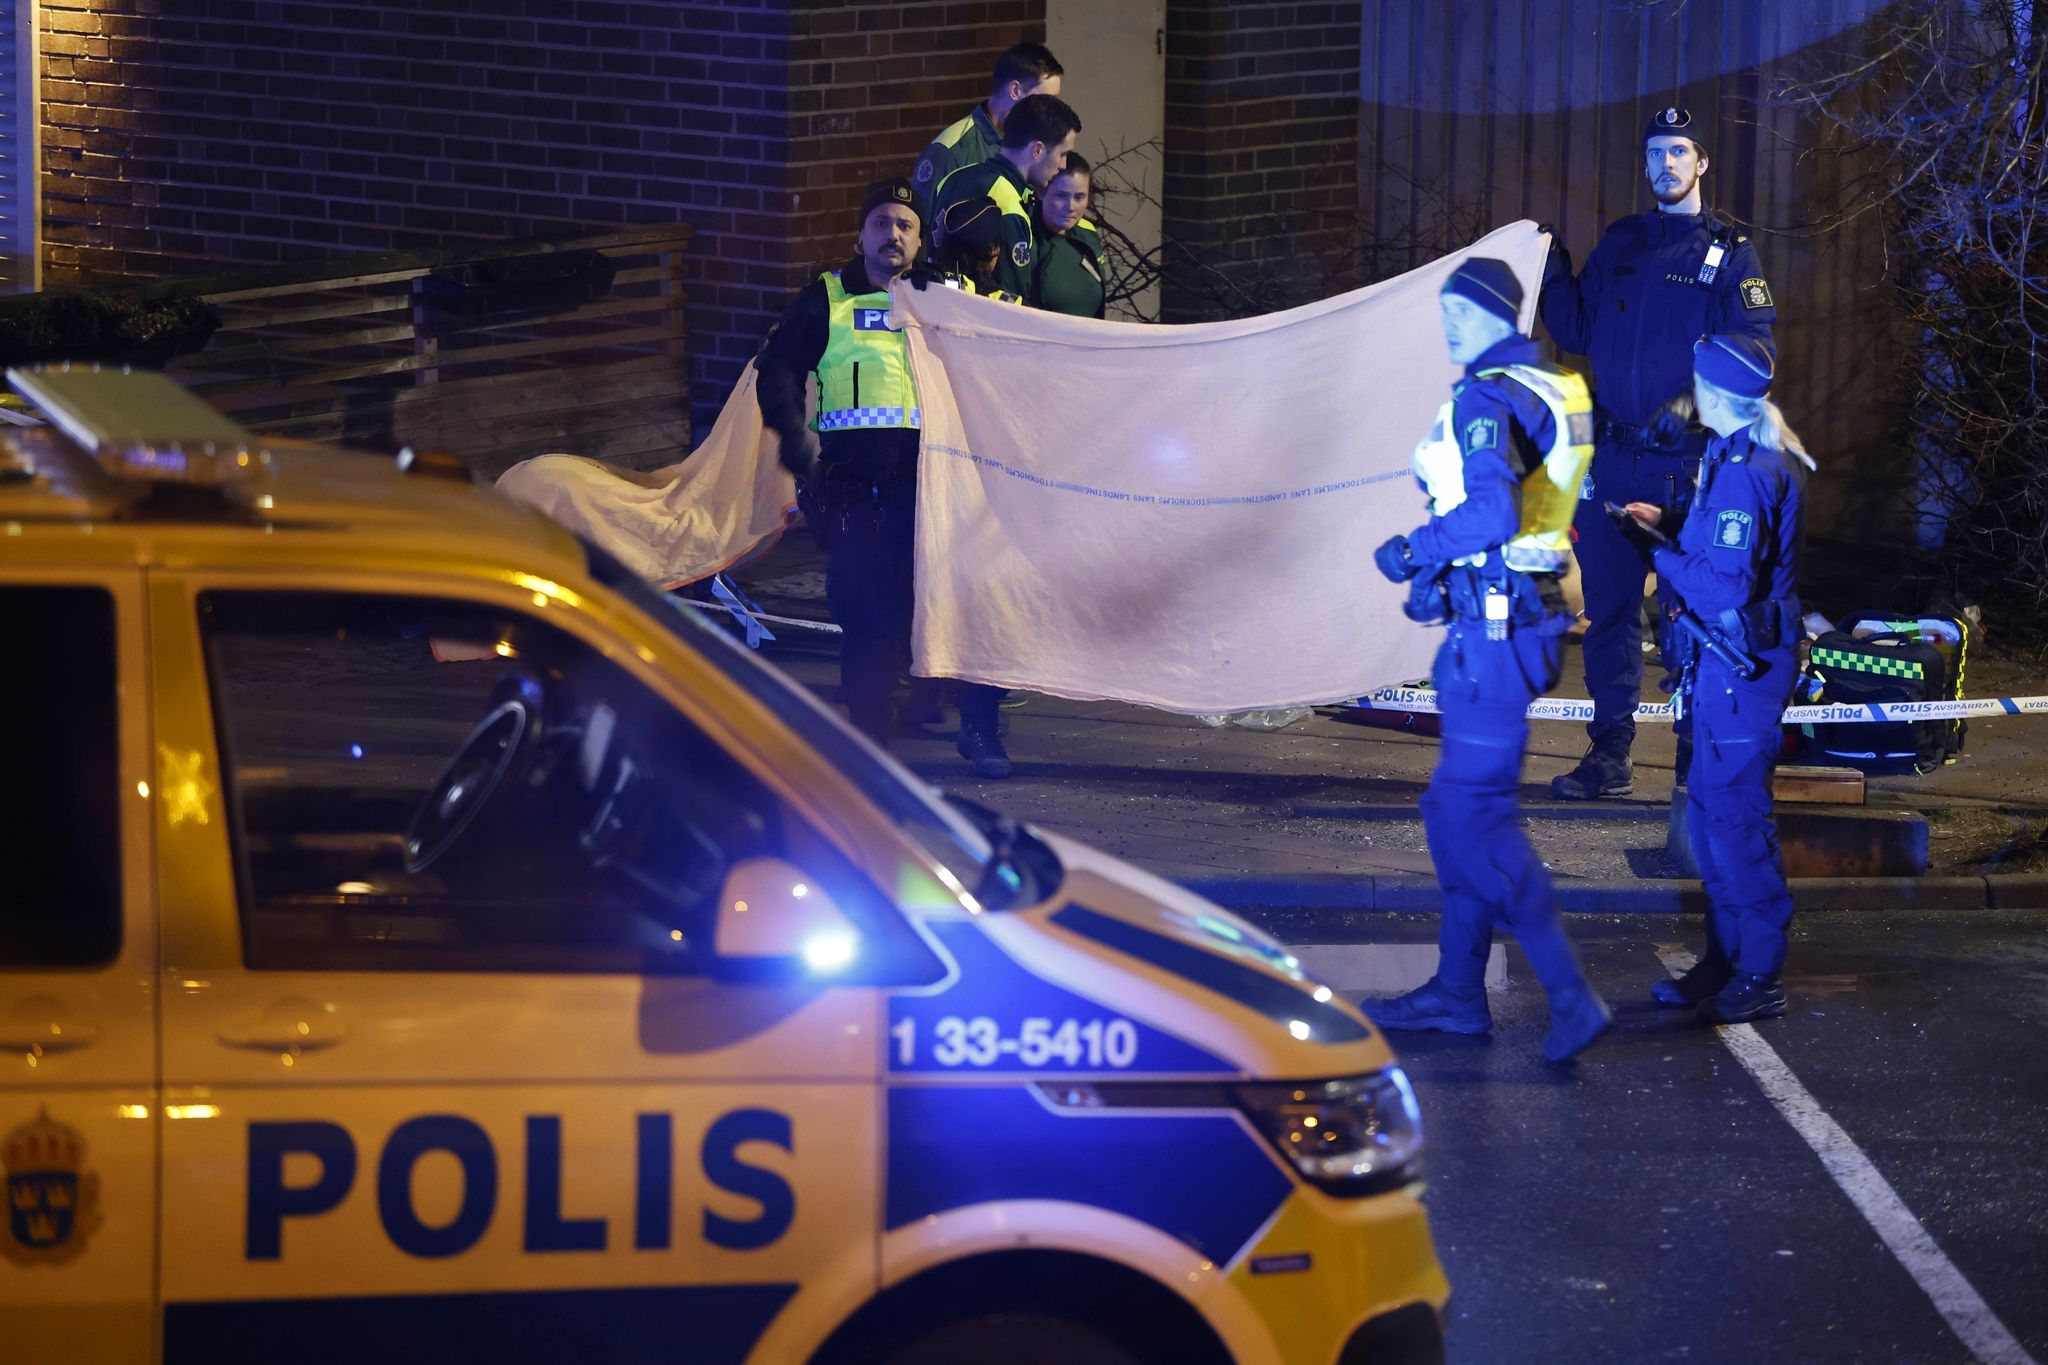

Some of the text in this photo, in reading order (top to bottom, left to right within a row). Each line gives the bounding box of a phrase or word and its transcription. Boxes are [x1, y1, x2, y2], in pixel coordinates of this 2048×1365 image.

[1666, 274, 1694, 284] POLIS
[1741, 279, 1765, 289] POLIS
[1005, 467, 1055, 487] STOCKHOLMS
[1314, 478, 1367, 496] STOCKHOLMS
[1084, 486, 1130, 501] LANDSTING
[1241, 492, 1287, 504] LANDSTING
[1159, 497, 1210, 506] STOCKHOLMS
[1721, 512, 1749, 524] POLIS
[1528, 705, 1594, 717] OLIS AVSPÄ
[1639, 703, 1672, 714] OLIS
[1786, 707, 1863, 719] POLIS AVSPÄ
[1889, 703, 1932, 713] POLIS
[891, 1016, 1139, 1067] 1 33-5410
[244, 1106, 797, 1263] POLIS
